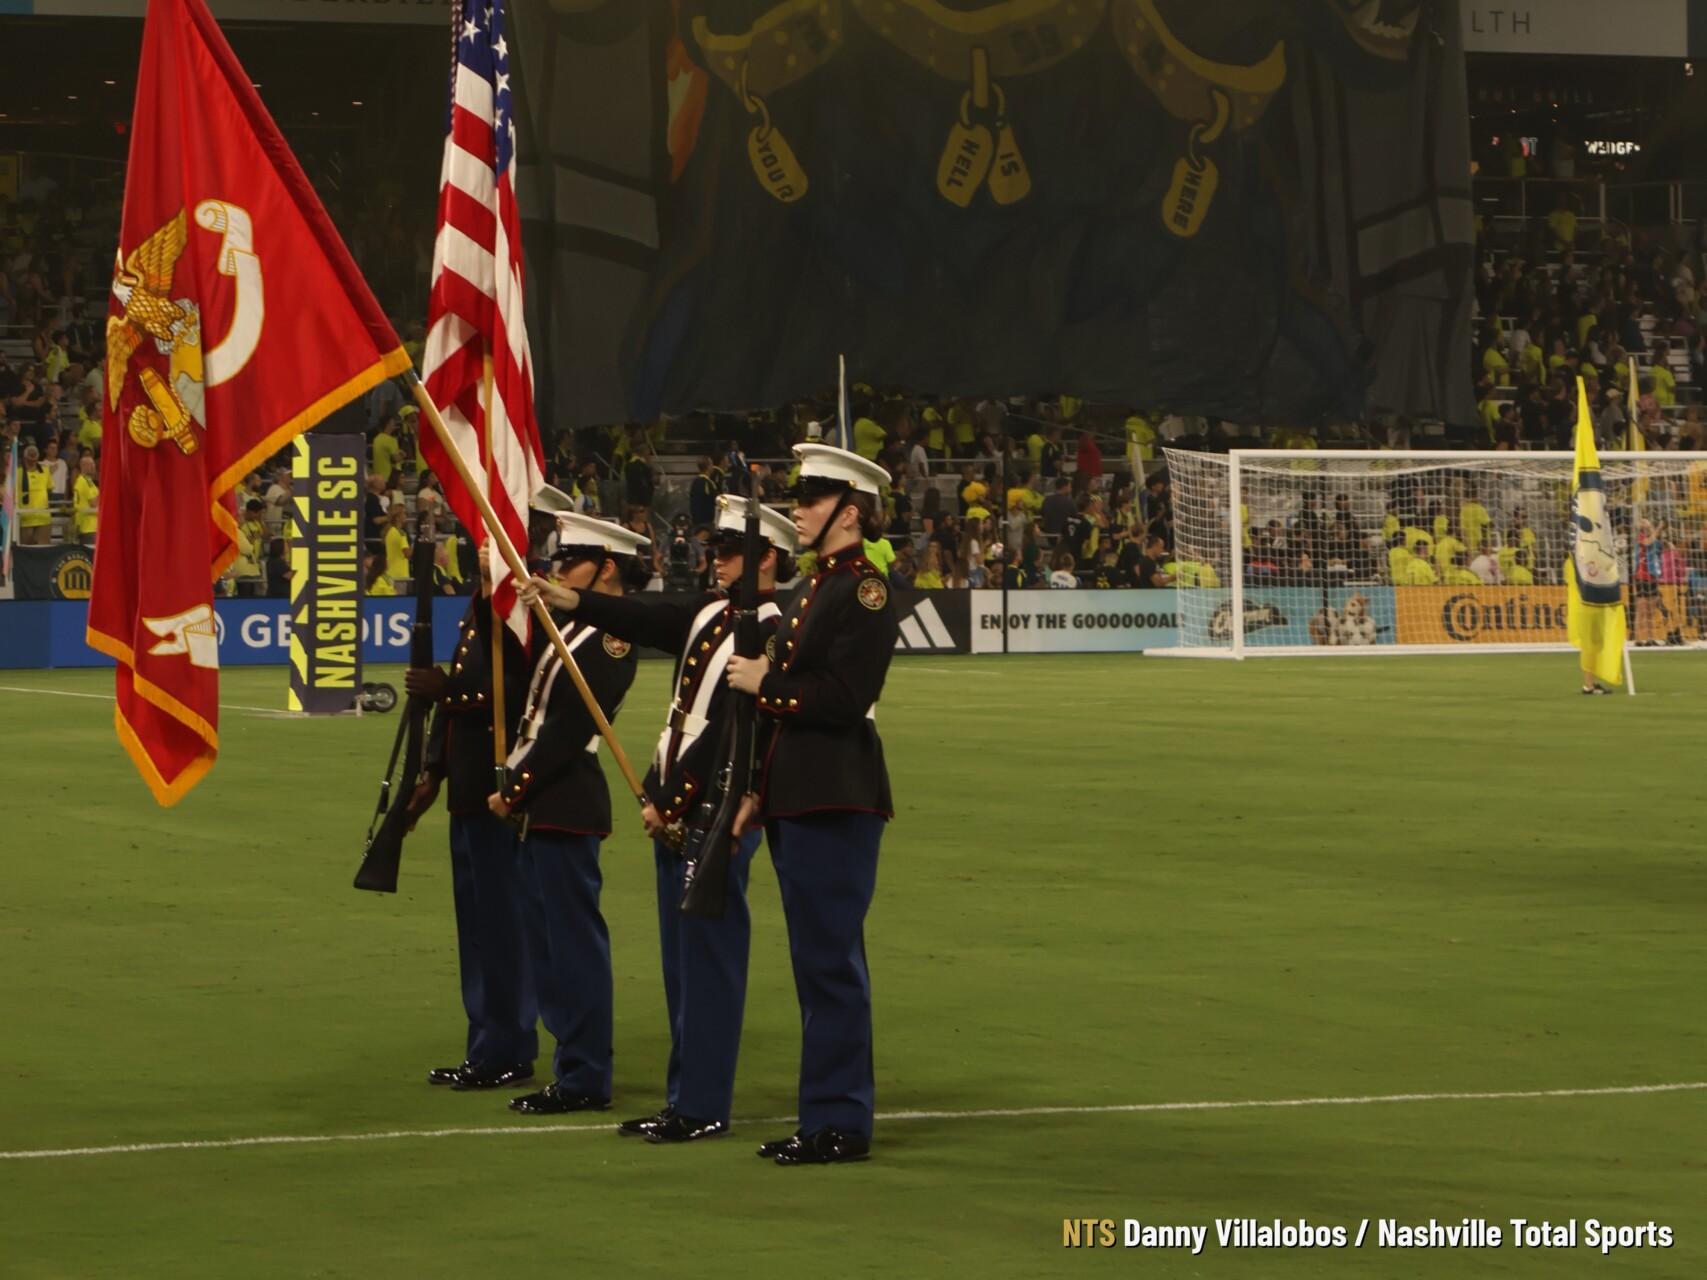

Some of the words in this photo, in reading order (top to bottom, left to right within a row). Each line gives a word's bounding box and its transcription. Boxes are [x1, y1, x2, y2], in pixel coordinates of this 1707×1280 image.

[758, 142, 794, 199] YOUR
[945, 138, 981, 189] HELL
[999, 151, 1021, 178] IS
[1172, 168, 1203, 230] HERE
[317, 456, 358, 500] SC
[314, 510, 358, 688] NASHVILLE
[241, 612, 411, 649] GEIS
[1035, 614, 1067, 629] THE
